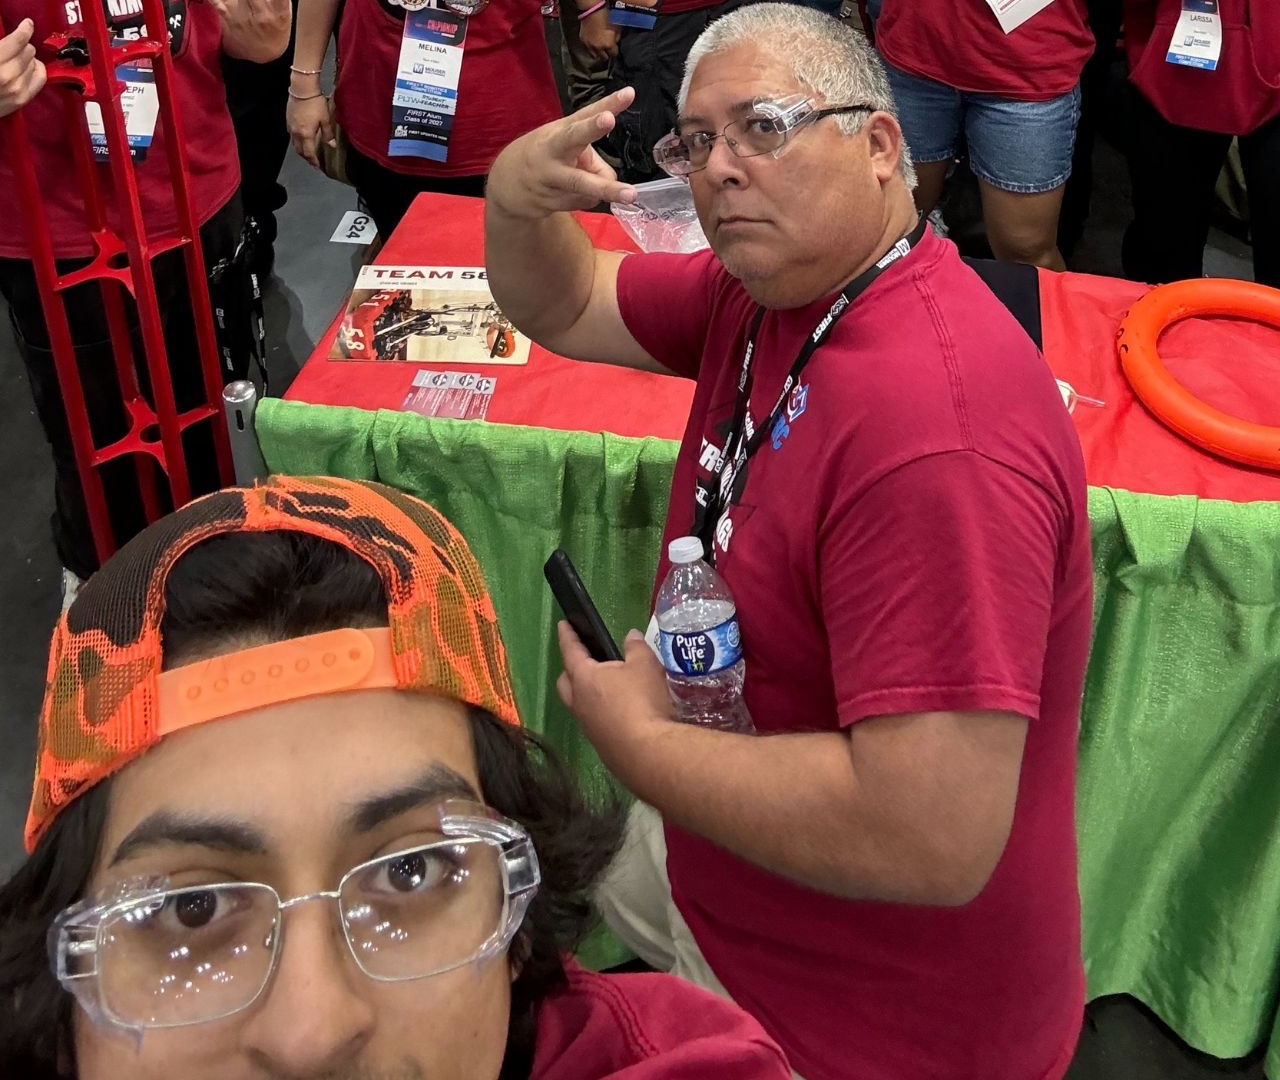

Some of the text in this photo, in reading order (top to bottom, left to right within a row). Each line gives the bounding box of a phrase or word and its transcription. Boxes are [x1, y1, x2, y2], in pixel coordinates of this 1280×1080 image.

[1190, 15, 1213, 23] LARISSA
[418, 42, 448, 55] MELINA
[403, 115, 421, 123] Class
[406, 109, 426, 118] FIRST
[346, 216, 370, 240] G24
[373, 269, 454, 280] TEAM
[812, 313, 834, 343] FIRST
[743, 340, 755, 370] FIRST
[676, 635, 707, 648] Pure
[682, 647, 706, 662] Life
